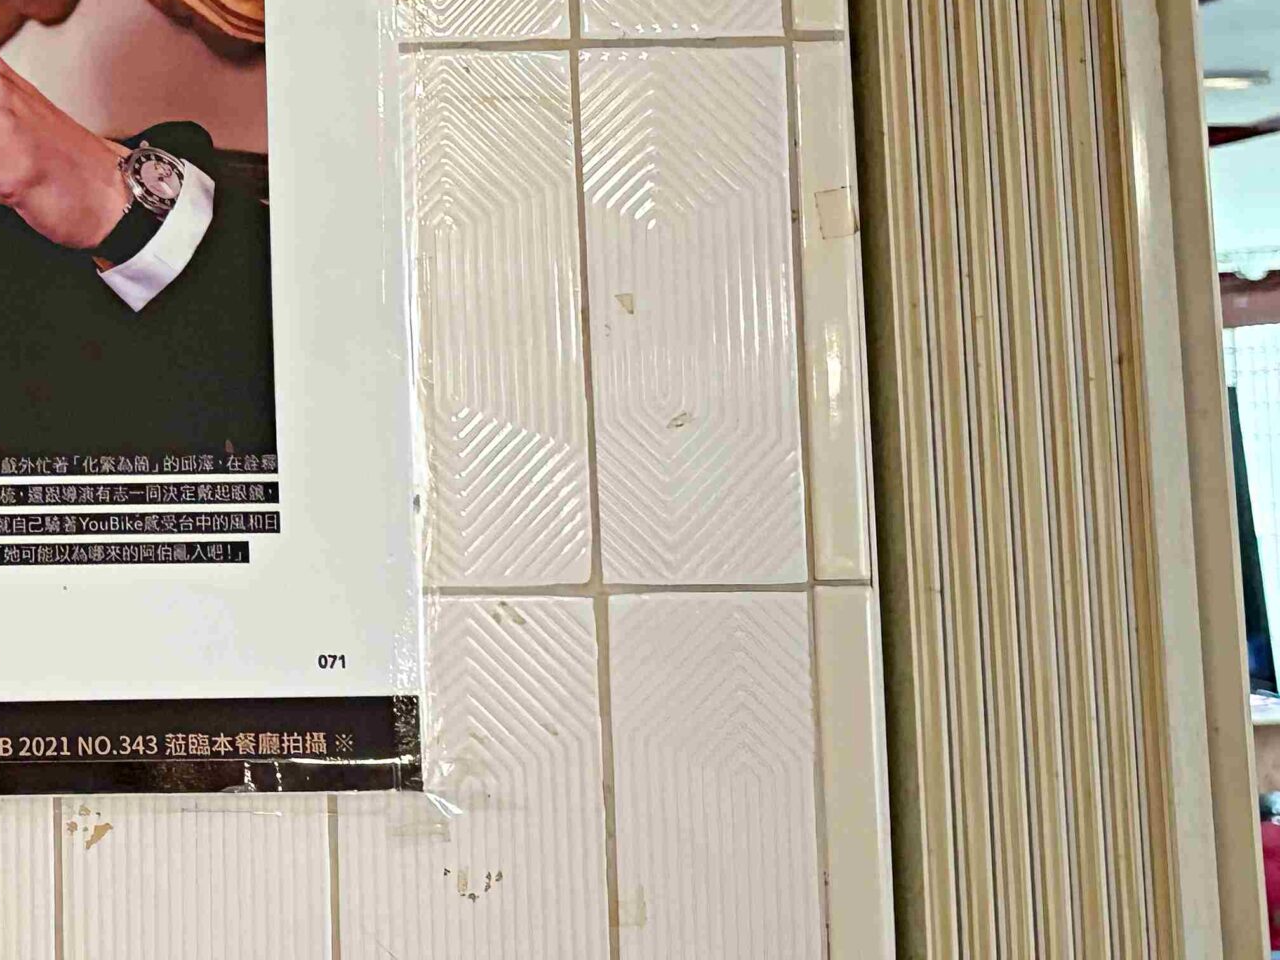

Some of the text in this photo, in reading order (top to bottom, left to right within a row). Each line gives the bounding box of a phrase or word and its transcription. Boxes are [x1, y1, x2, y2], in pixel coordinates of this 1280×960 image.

[317, 653, 347, 670] 071
[18, 735, 72, 757] 2021
[77, 734, 159, 756] NO.343
